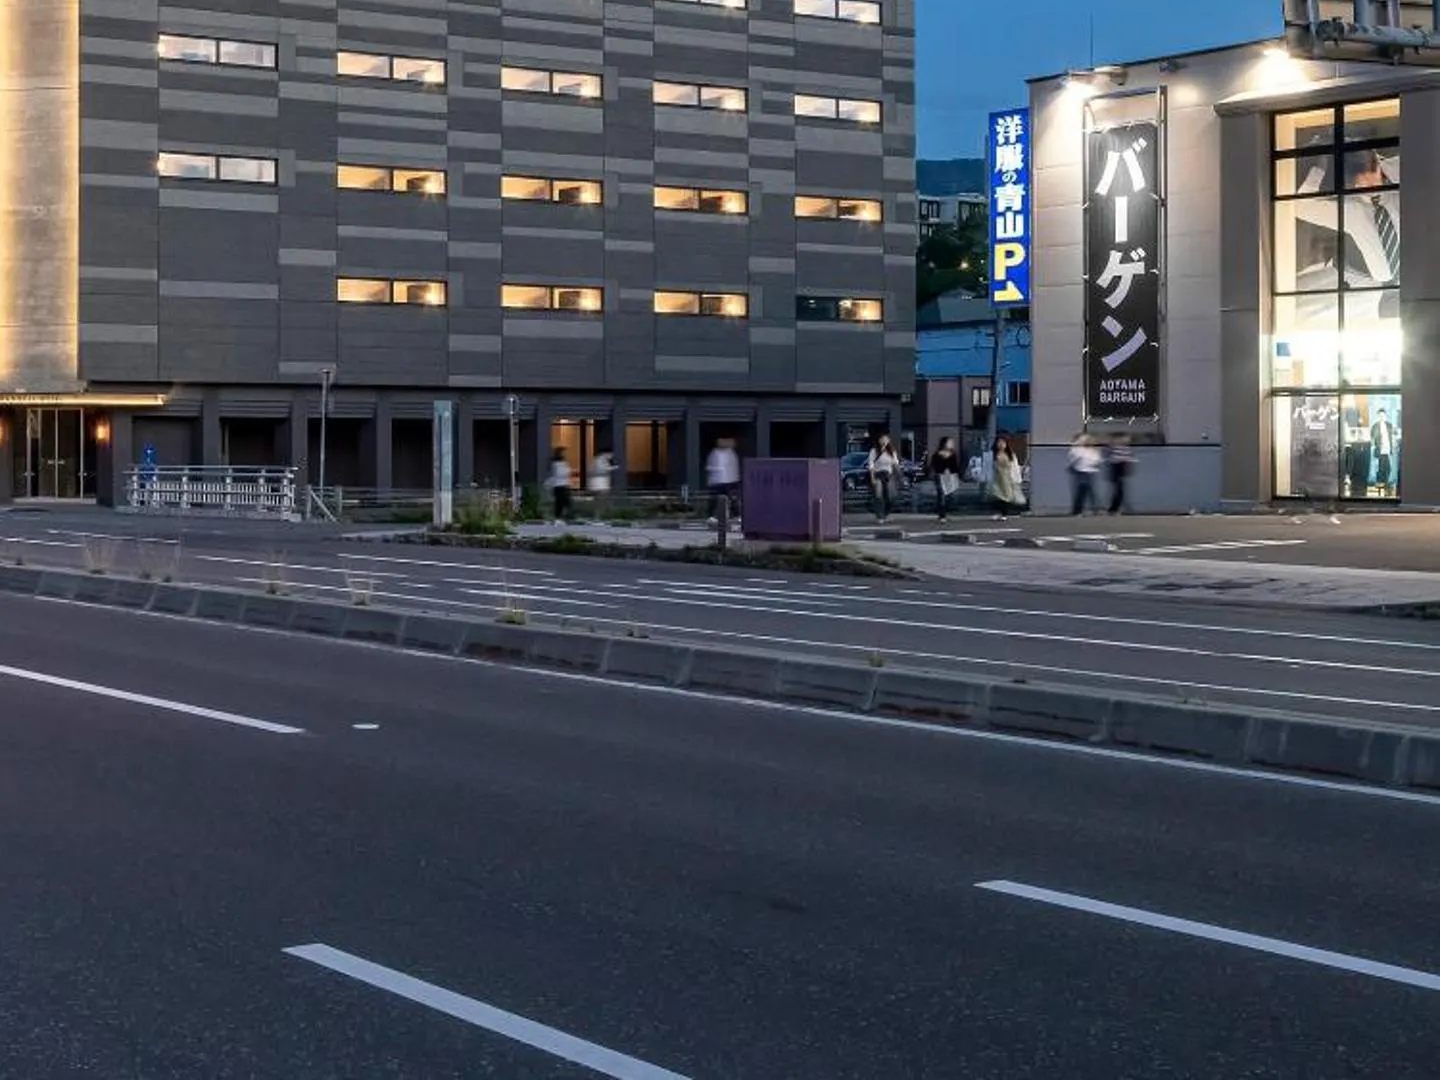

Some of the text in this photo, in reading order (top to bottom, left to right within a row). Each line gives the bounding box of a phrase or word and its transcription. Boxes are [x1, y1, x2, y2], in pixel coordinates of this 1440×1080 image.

[994, 115, 1025, 239] 洋服の青山
[994, 242, 1026, 281] P
[1094, 137, 1147, 372] バーゲン
[1100, 379, 1145, 390] AOYAMA
[1100, 392, 1145, 403] BARGAIN
